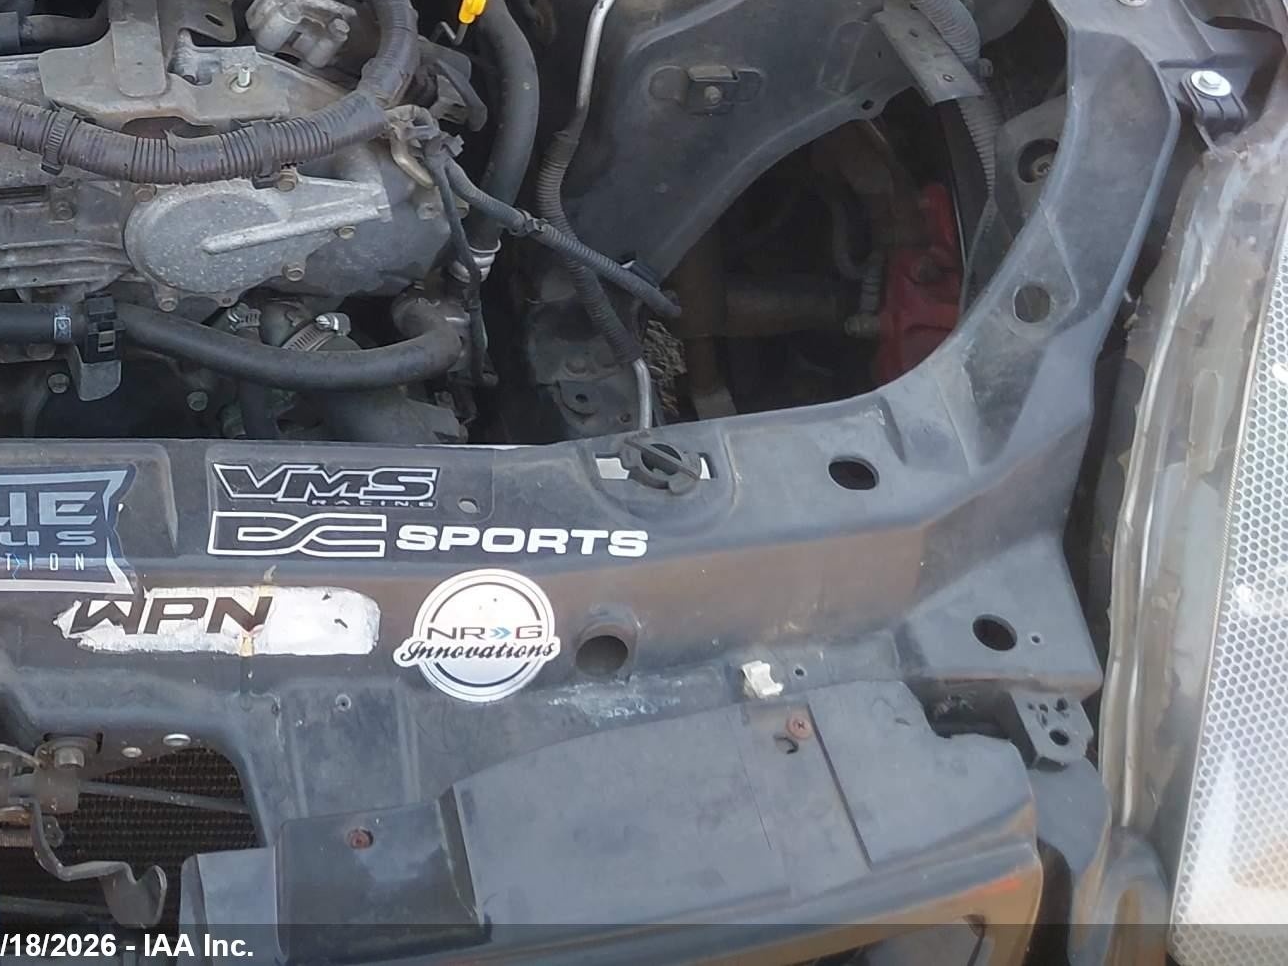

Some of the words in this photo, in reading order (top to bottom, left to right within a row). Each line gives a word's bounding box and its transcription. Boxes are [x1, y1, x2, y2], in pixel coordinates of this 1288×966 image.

[213, 462, 440, 503] VMS
[311, 499, 434, 508] RACING
[206, 510, 388, 558] DC
[396, 524, 650, 558] SPORTS
[399, 640, 556, 662] Innovations
